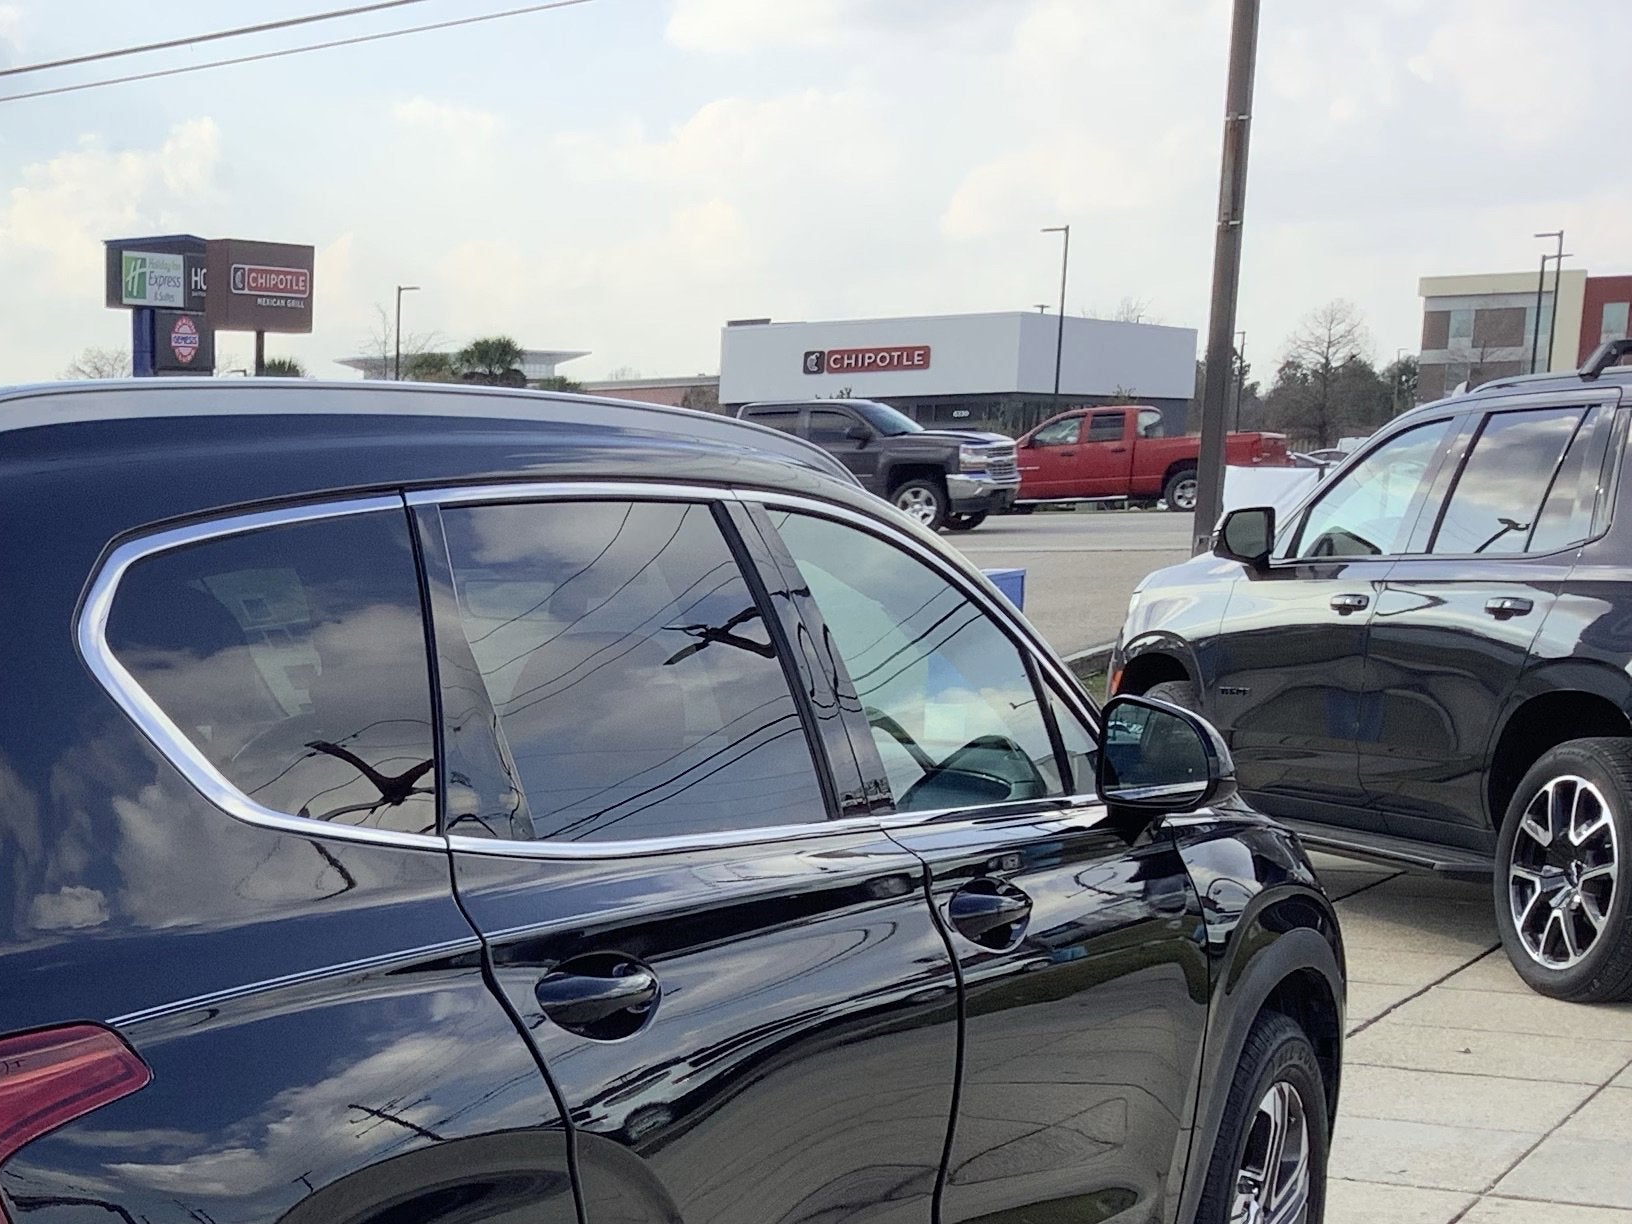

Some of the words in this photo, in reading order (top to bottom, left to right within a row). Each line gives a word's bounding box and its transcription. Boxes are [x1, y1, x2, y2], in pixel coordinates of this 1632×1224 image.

[148, 271, 181, 289] Express
[249, 273, 306, 290] CHIPOTLE
[257, 297, 286, 306] MEXICAN
[287, 299, 305, 308] GRILL
[829, 350, 925, 369] CHIPOTLE
